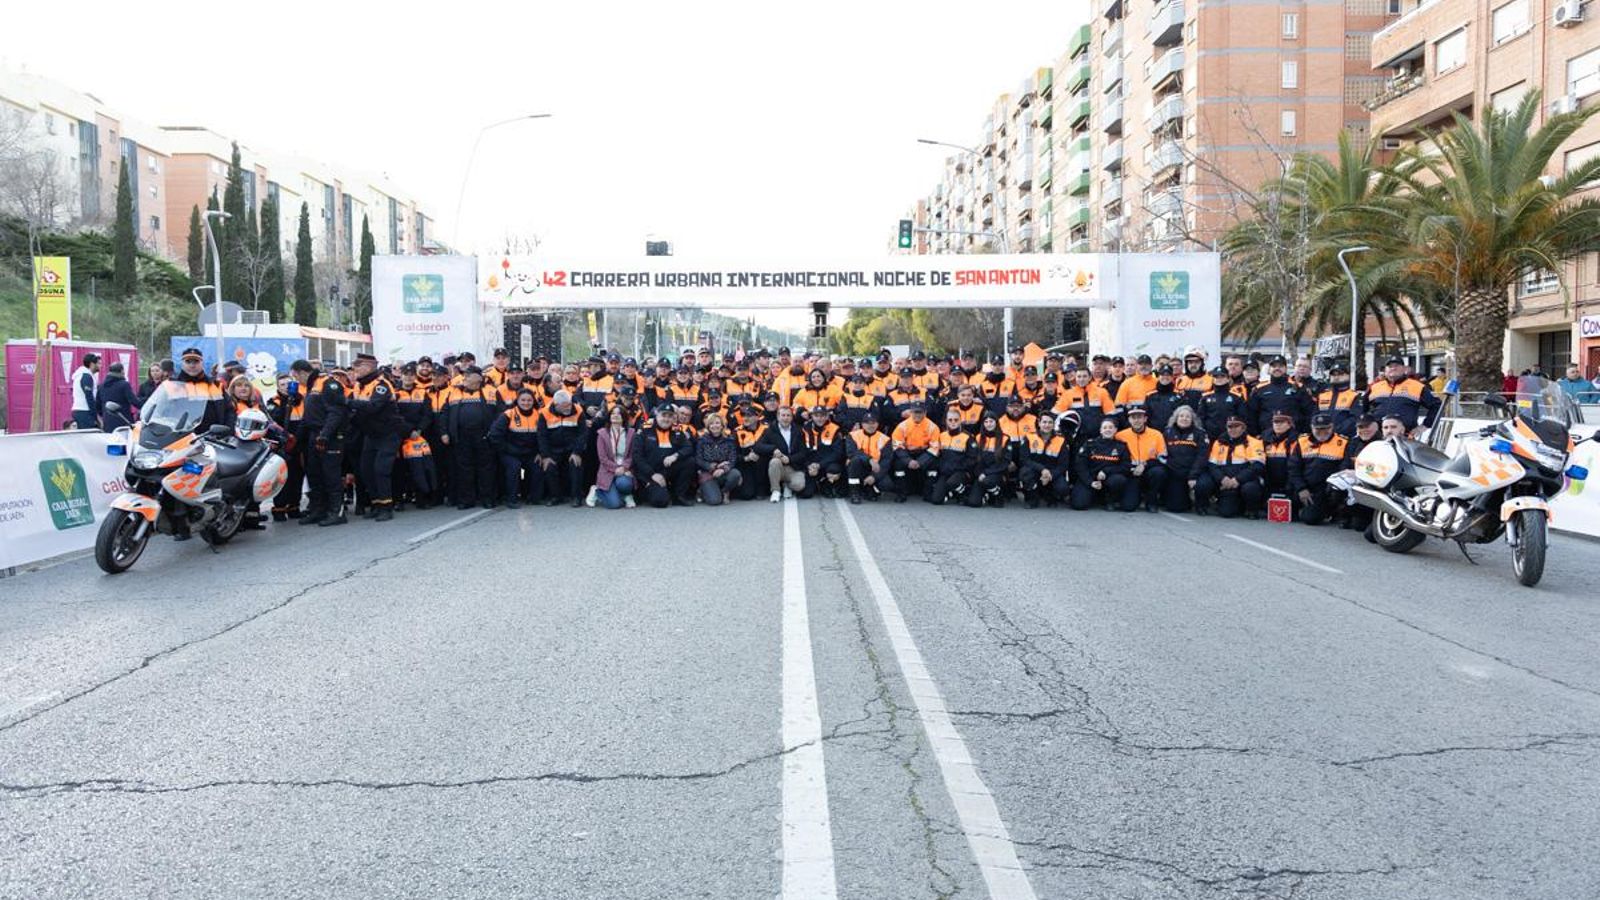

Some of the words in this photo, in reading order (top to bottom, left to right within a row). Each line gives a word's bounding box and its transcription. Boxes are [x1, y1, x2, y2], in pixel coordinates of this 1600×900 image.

[543, 270, 567, 287] 42
[571, 271, 650, 287] CARRERA
[655, 271, 723, 287] URBANA
[726, 271, 869, 287] INTERNACIONAL
[874, 271, 926, 286] NOCHE
[930, 270, 951, 286] DE
[955, 269, 986, 286] SAN
